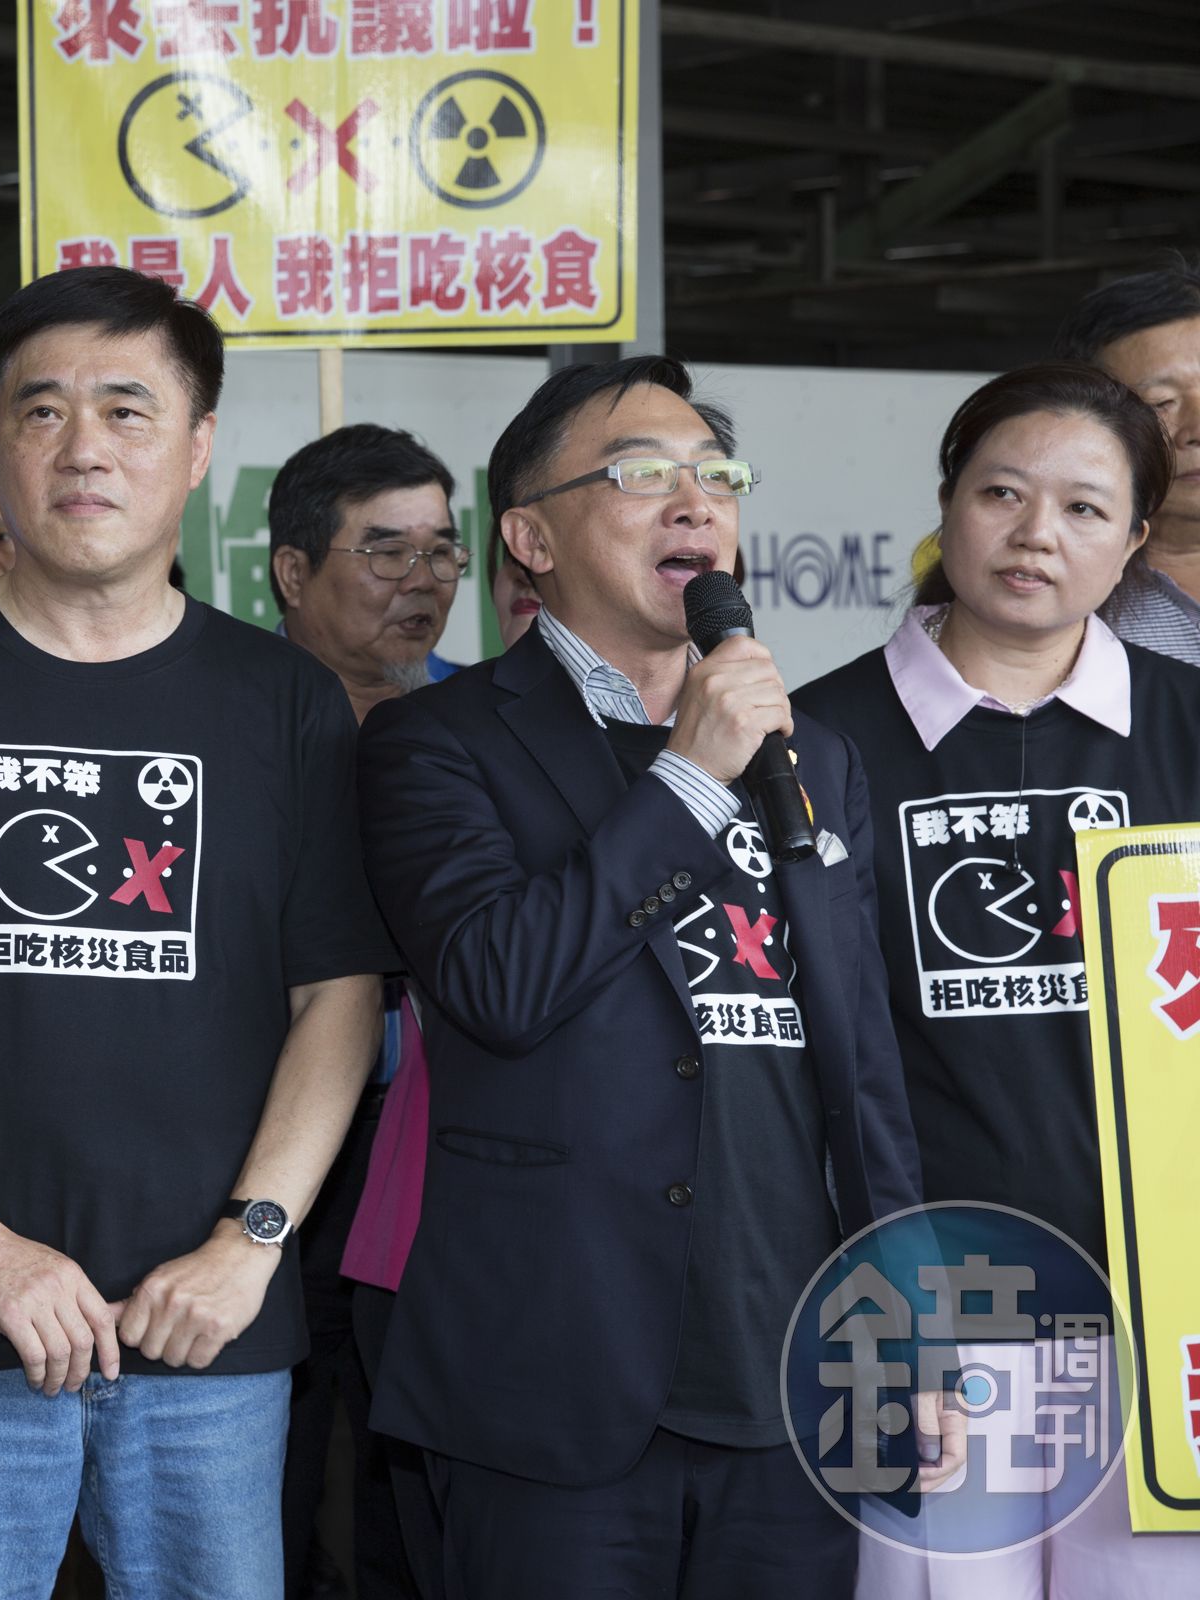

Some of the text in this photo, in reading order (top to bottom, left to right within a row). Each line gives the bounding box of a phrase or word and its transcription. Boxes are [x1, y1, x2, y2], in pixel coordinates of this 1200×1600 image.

[275, 230, 599, 315] 我拒吃核食
[751, 533, 893, 609] HOME
[912, 803, 1031, 847] 我不笨
